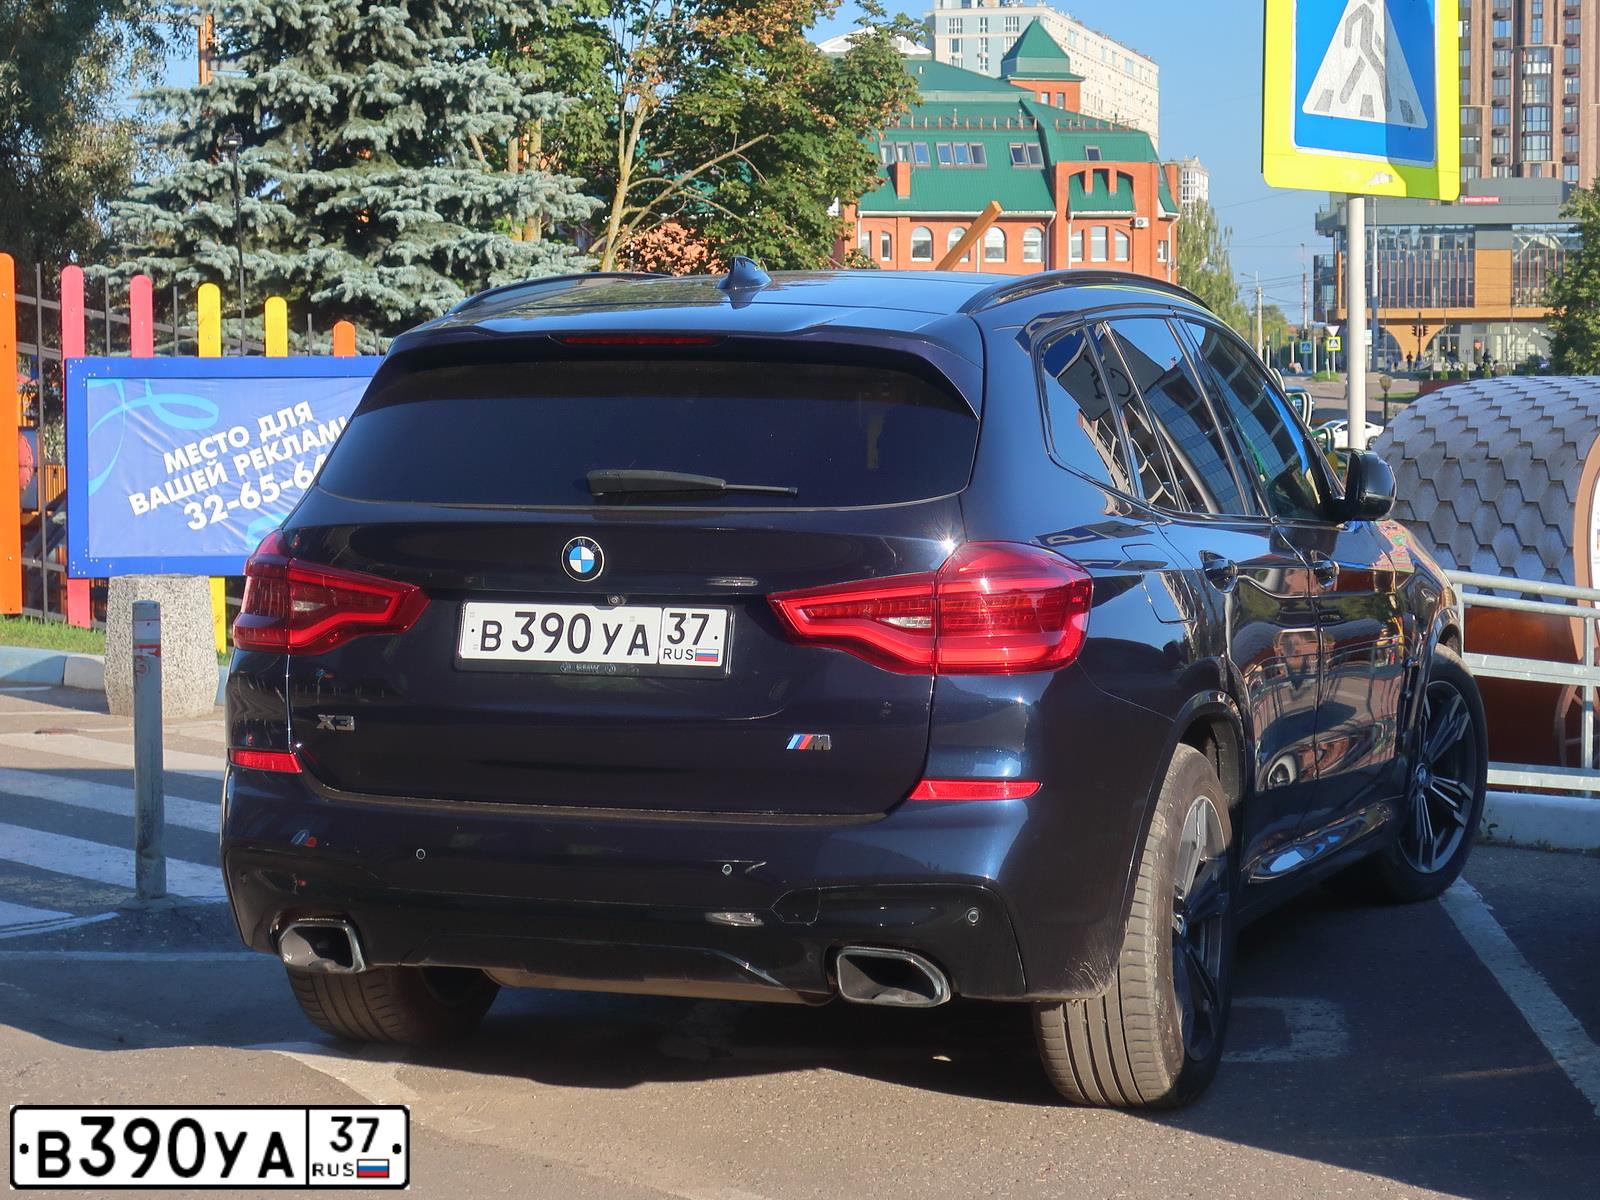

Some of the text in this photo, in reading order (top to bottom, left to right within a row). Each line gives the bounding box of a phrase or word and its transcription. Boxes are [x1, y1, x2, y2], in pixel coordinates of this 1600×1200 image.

[163, 401, 314, 474] МЕСТО ДЛЯ
[128, 460, 228, 516] ВАШЕЙ
[667, 613, 709, 645] 37
[663, 648, 694, 660] RUS
[316, 714, 355, 731] X3
